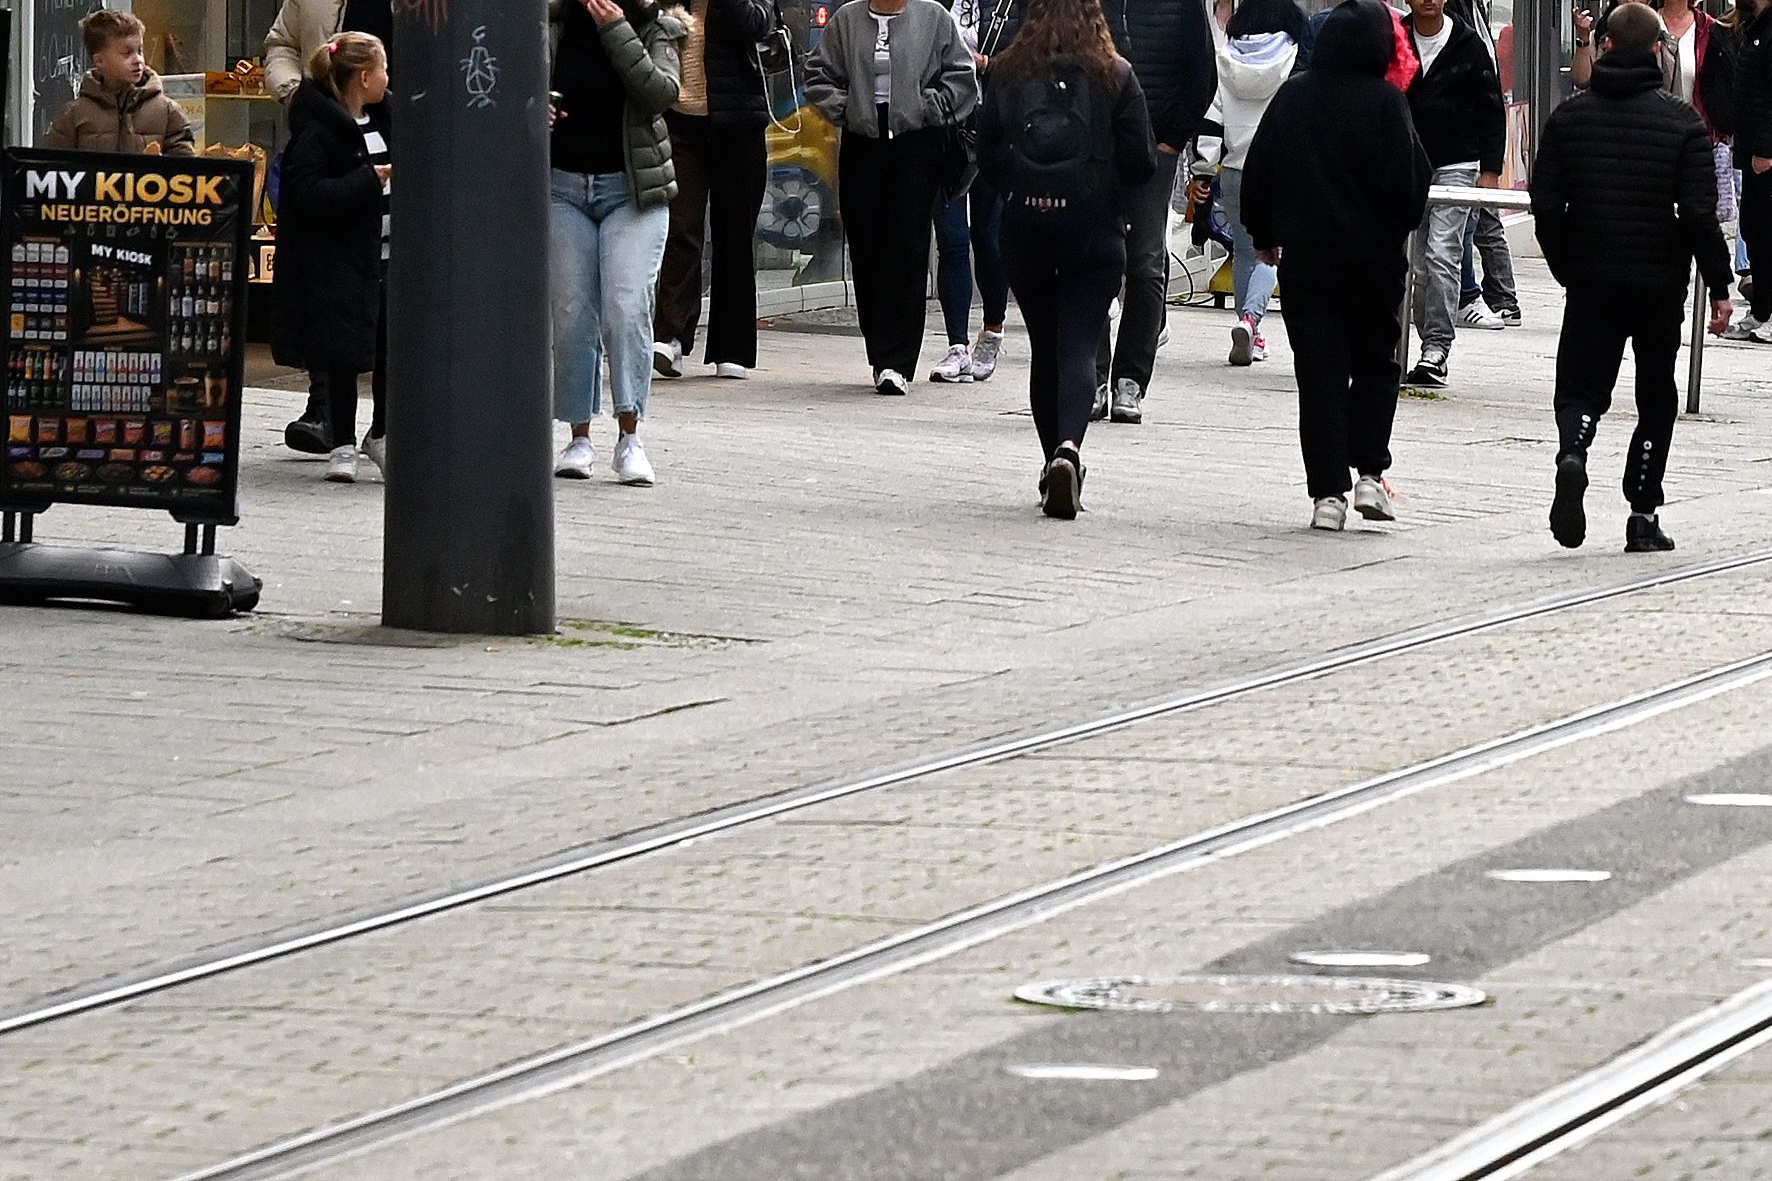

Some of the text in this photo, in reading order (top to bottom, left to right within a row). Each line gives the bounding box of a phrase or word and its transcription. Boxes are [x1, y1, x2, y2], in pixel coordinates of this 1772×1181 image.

[26, 170, 224, 205] MY KIOSK
[41, 203, 212, 226] NEUERÖFFNUNG
[91, 243, 153, 266] MY KIOSK
